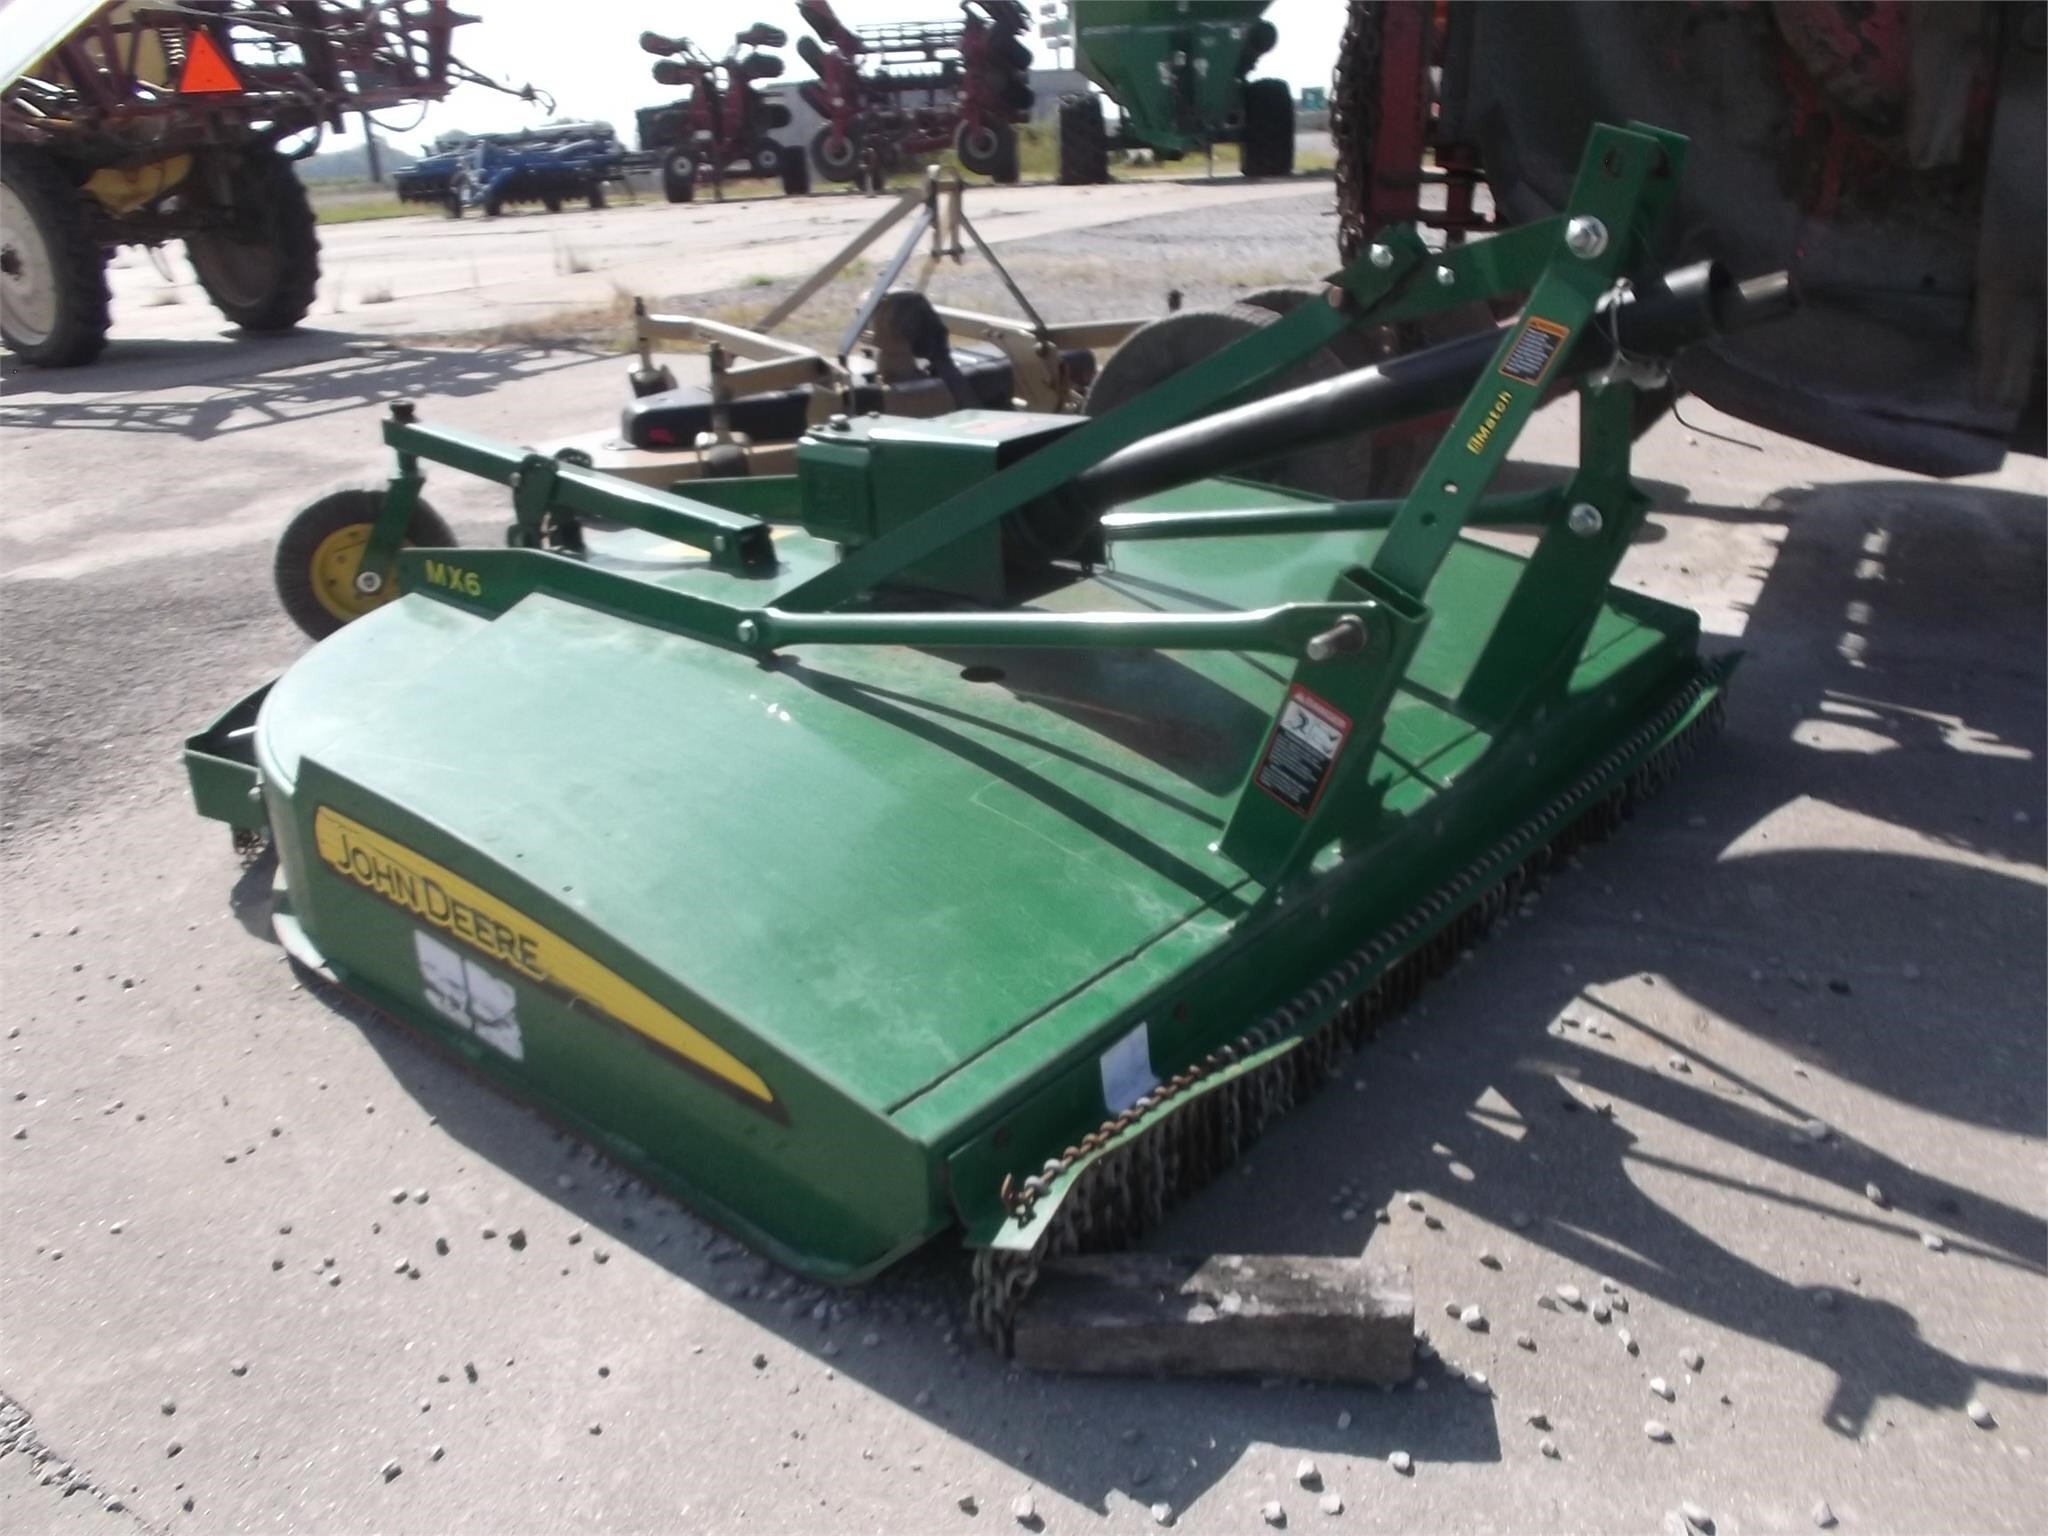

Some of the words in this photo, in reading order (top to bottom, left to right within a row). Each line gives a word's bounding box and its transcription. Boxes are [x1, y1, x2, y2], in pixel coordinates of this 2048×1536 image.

[424, 559, 482, 597] MX6
[335, 833, 420, 914] JOHN
[421, 876, 543, 972] DEERE
